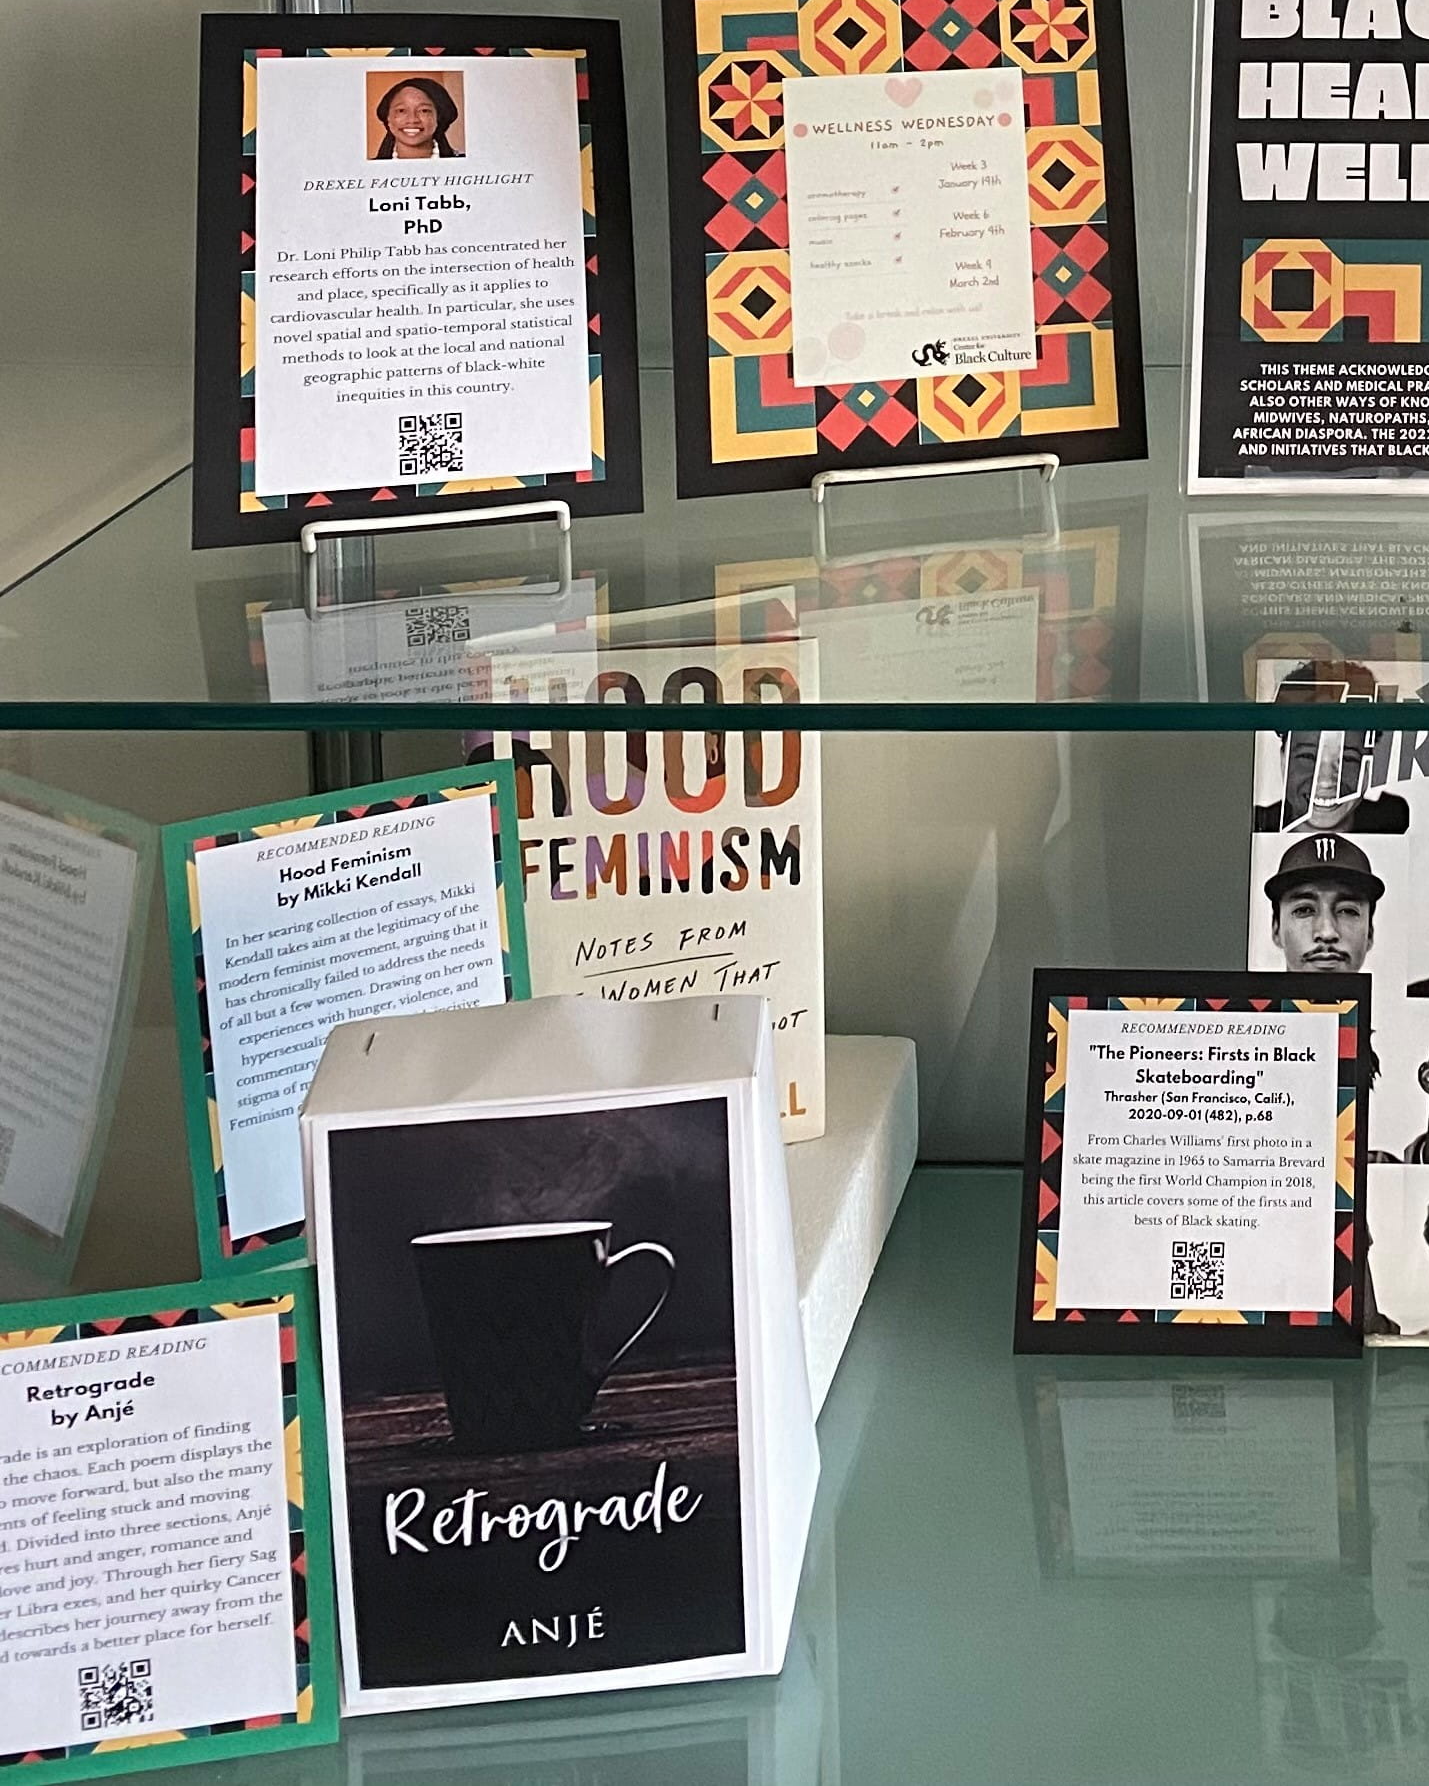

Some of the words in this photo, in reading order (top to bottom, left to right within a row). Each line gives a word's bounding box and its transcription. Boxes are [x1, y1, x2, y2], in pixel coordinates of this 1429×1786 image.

[813, 119, 893, 135] WELLNESS
[901, 115, 995, 131] WEDNESDAY
[870, 140, 899, 150] 11am
[920, 138, 944, 150] 2pm
[303, 178, 365, 191] DREXEL
[369, 175, 440, 189] FACULTY
[443, 173, 534, 186] HIGHLIGHT
[368, 195, 409, 212] Loni
[414, 193, 471, 212] Tabb,
[403, 217, 442, 235] PhD
[954, 349, 986, 365] Black
[987, 349, 1032, 363] Culture
[1237, 442, 1268, 455] AND
[1270, 443, 1347, 456] INITIATIVES
[1349, 443, 1385, 456] THAT
[511, 667, 801, 818] HOOD
[256, 829, 368, 862] RECOMMENDED
[371, 815, 435, 838] READING
[278, 858, 326, 883] Hood
[330, 846, 411, 872] Feminism
[520, 824, 801, 903] FEMINISM
[276, 891, 300, 909] by
[303, 876, 351, 902] Mikki
[355, 861, 421, 890] Kendall
[575, 931, 654, 966] NOTES
[678, 919, 747, 951] FROM
[600, 969, 698, 1001] WOMEN
[714, 960, 780, 992] THAT
[1120, 1022, 1224, 1034] RECOMMENDED
[1226, 1023, 1286, 1035] READING
[1088, 1043, 1125, 1060] "The
[1128, 1044, 1203, 1061] Pioneers:
[1207, 1045, 1250, 1062] Firsts
[1253, 1045, 1269, 1062] in
[1272, 1046, 1316, 1062] Black
[1134, 1067, 1264, 1089] Skateboarding"
[1103, 1089, 1158, 1102] Thrasher
[1160, 1090, 1189, 1106] (San
[1191, 1090, 1251, 1105] Francisco,
[1253, 1091, 1295, 1107] Calif.),
[1127, 1107, 1202, 1121] 2020-09-01
[1203, 1108, 1242, 1124] (482),
[1244, 1109, 1273, 1124] p.68
[25, 1370, 155, 1403] Retrograde
[50, 1408, 79, 1429] by
[83, 1398, 134, 1423] Anjé
[385, 1461, 703, 1572] Retrograde
[500, 1611, 605, 1648] ANJÉ
